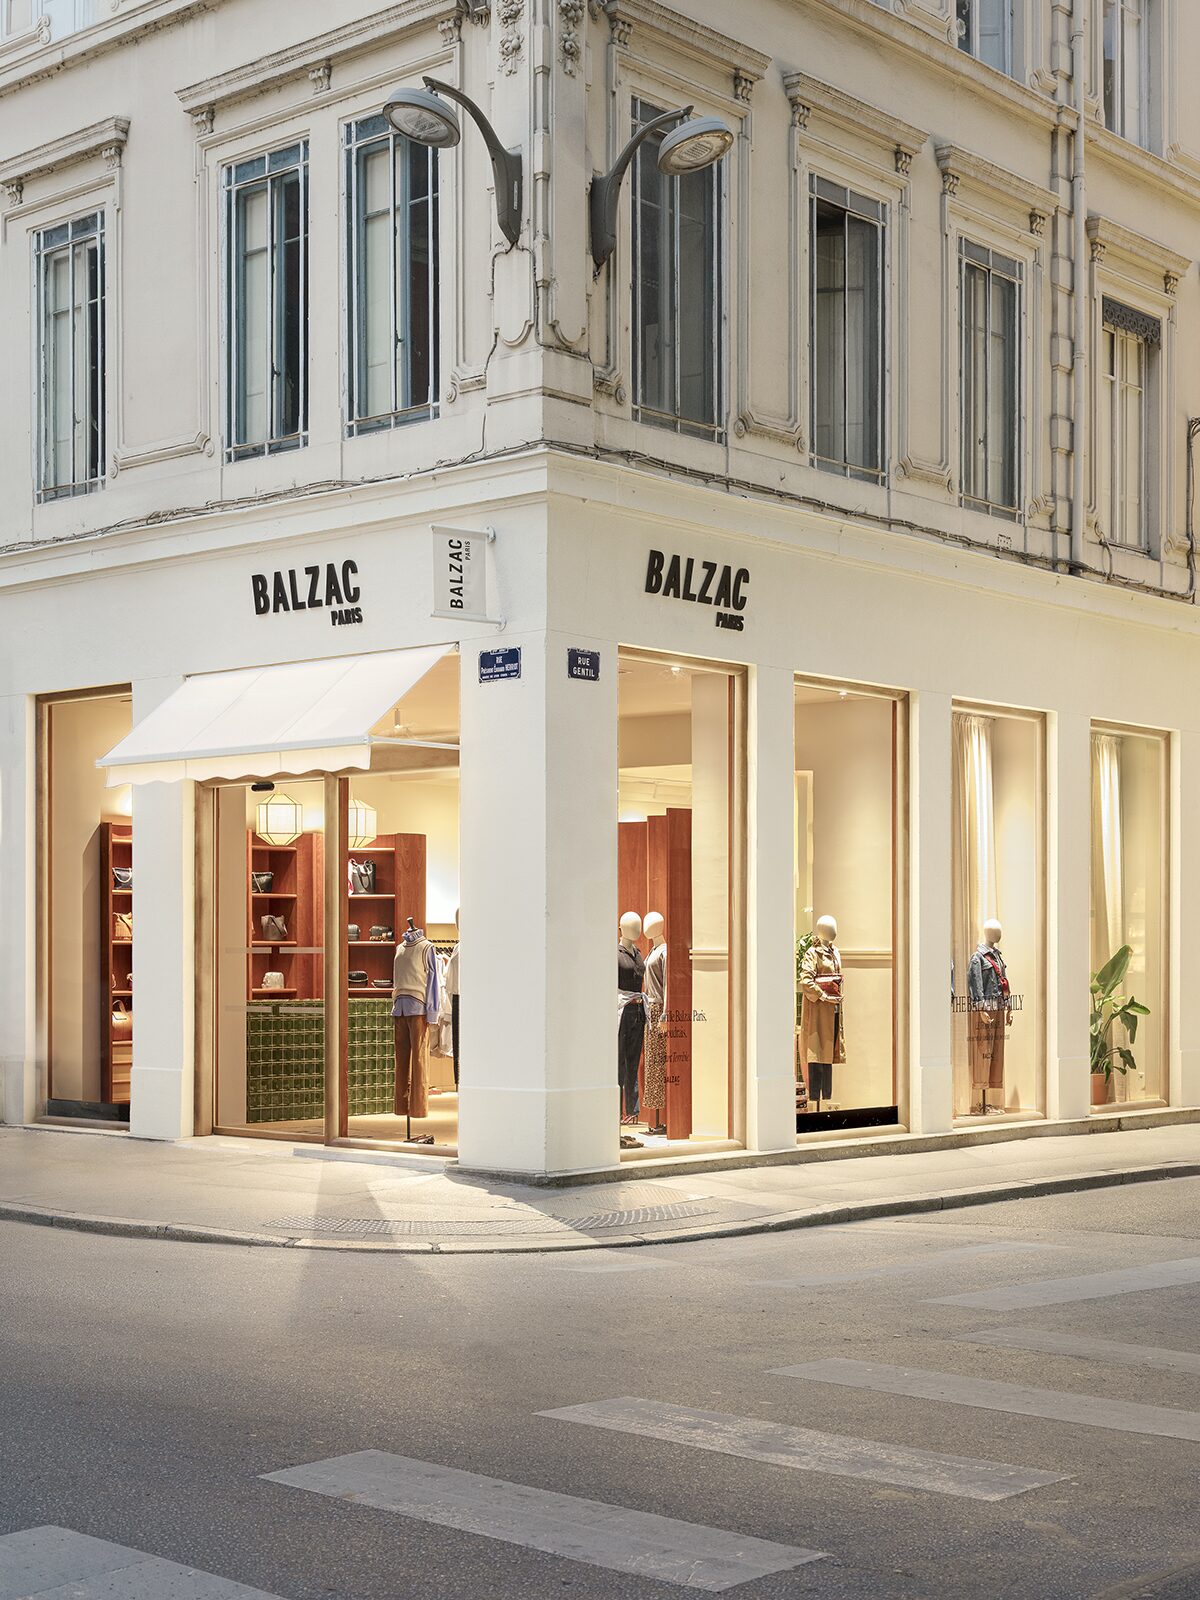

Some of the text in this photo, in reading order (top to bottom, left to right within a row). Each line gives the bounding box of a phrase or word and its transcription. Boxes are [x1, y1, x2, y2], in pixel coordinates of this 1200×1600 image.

[448, 539, 464, 609] BALZAC
[645, 549, 750, 611] BALZAC
[252, 559, 360, 615] BALZAC
[331, 607, 363, 626] PARIS
[715, 611, 745, 631] PARIS
[495, 655, 503, 664] RUE
[577, 656, 590, 666] RUE
[572, 666, 595, 677] GENTIL
[952, 996, 966, 1013] THE
